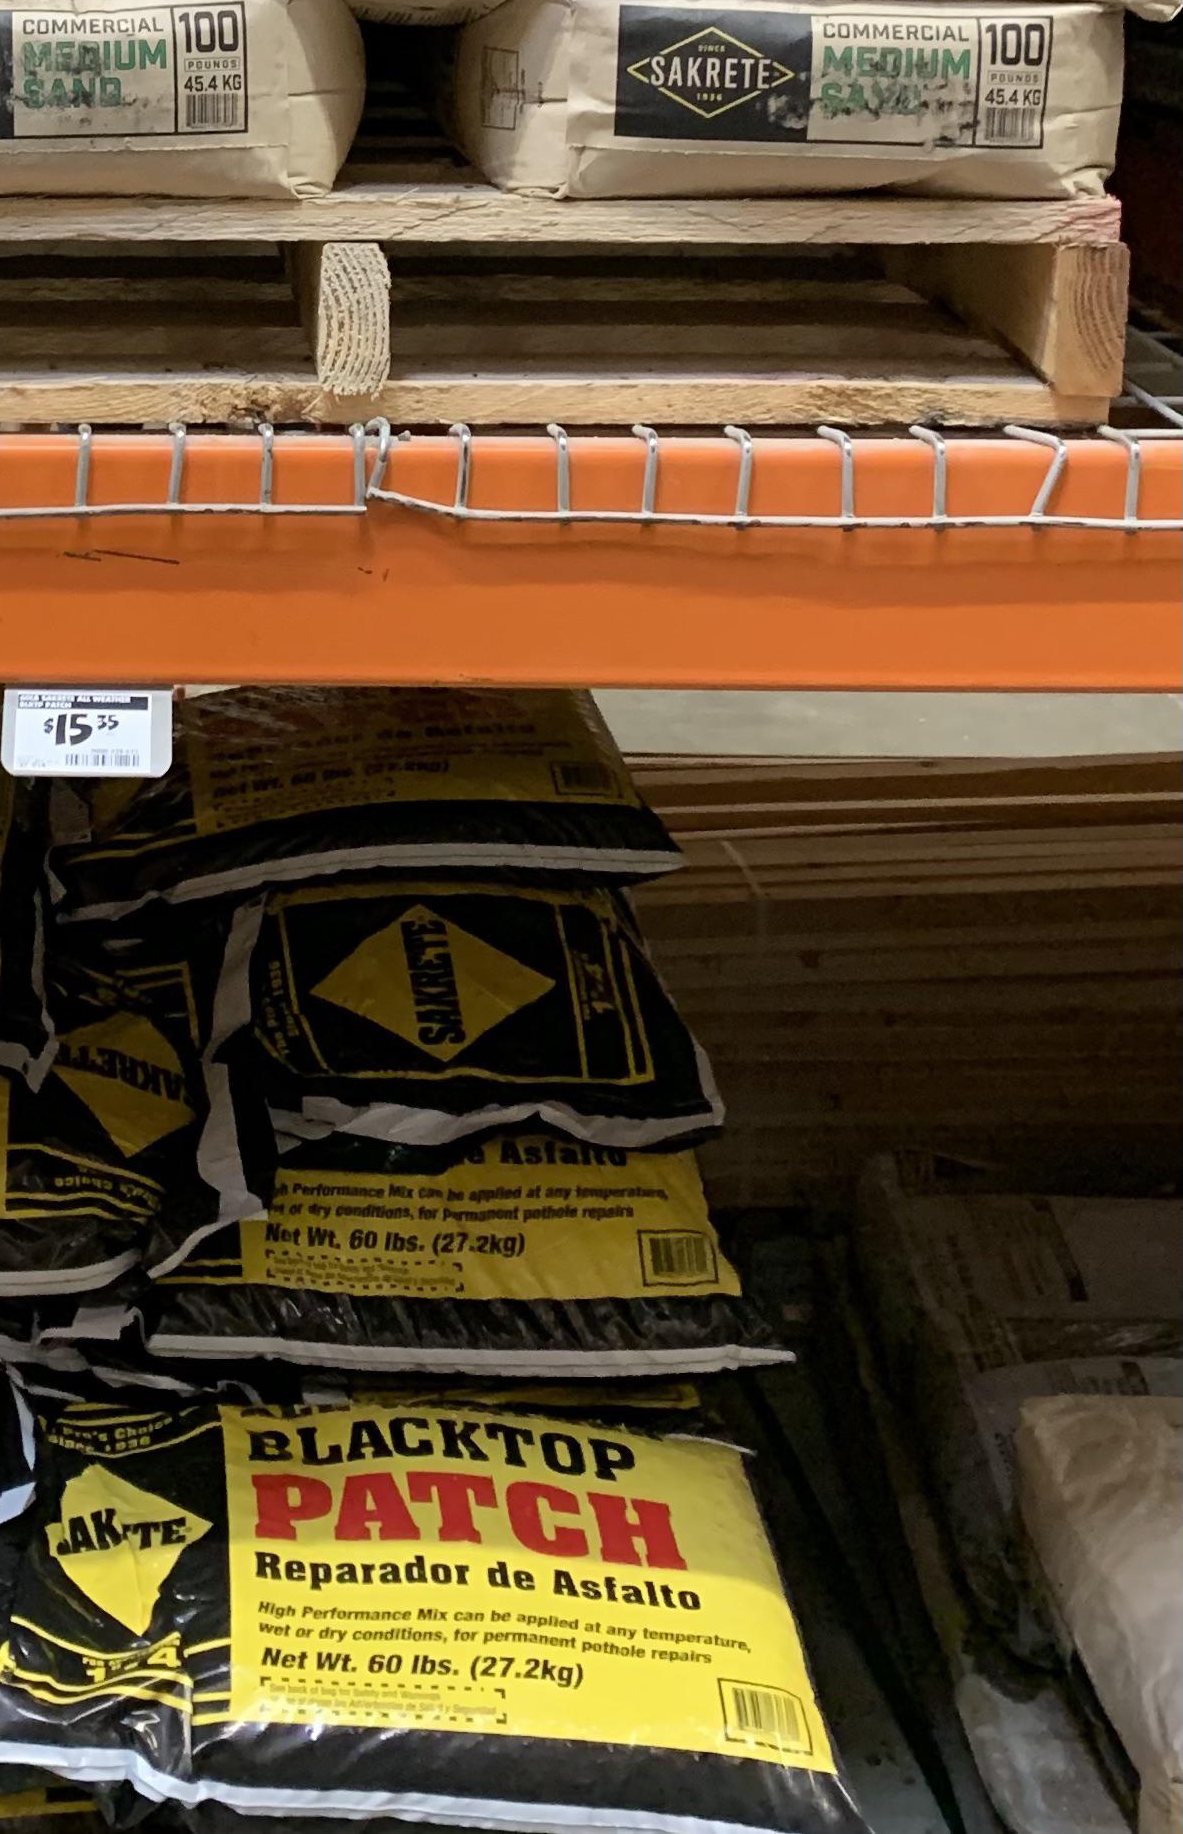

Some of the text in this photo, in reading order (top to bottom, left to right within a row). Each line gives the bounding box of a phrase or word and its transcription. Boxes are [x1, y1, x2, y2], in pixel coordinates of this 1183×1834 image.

[22, 17, 164, 35] COMMERCIAL
[179, 11, 239, 54] 100
[823, 22, 969, 43] COMMERCIAL
[23, 38, 168, 72] MEDIUM
[822, 45, 971, 80] MEDIUM
[986, 23, 1045, 67] 100
[187, 59, 239, 70] POUNDS
[649, 55, 772, 90] SAKRETE
[22, 76, 122, 109] SAND
[184, 73, 242, 92] 45.4 KG
[985, 88, 1042, 106] 45.4 KG
[400, 919, 466, 1047] SAKRETE
[293, 1181, 385, 1201] Performance
[389, 1182, 415, 1198] Mix
[469, 1186, 522, 1204] applied
[544, 1186, 572, 1204] any
[307, 1203, 332, 1220] dry
[335, 1204, 416, 1222] conditions,
[418, 1204, 439, 1222] for
[265, 1223, 526, 1258] Net Wt. 60 lbs. (27.2kg)
[248, 1416, 636, 1483] BLACKTOP
[250, 1471, 688, 1571] PATCH
[255, 1550, 702, 1613] Reparador de Asfalto
[258, 1600, 752, 1656] High Performance Mix can be applied at any temperature,
[258, 1623, 713, 1666] wet or dry conditions, for permanent pothole repairs
[260, 1647, 585, 1691] Net Wt. 60 lbs. (27.2kg)
